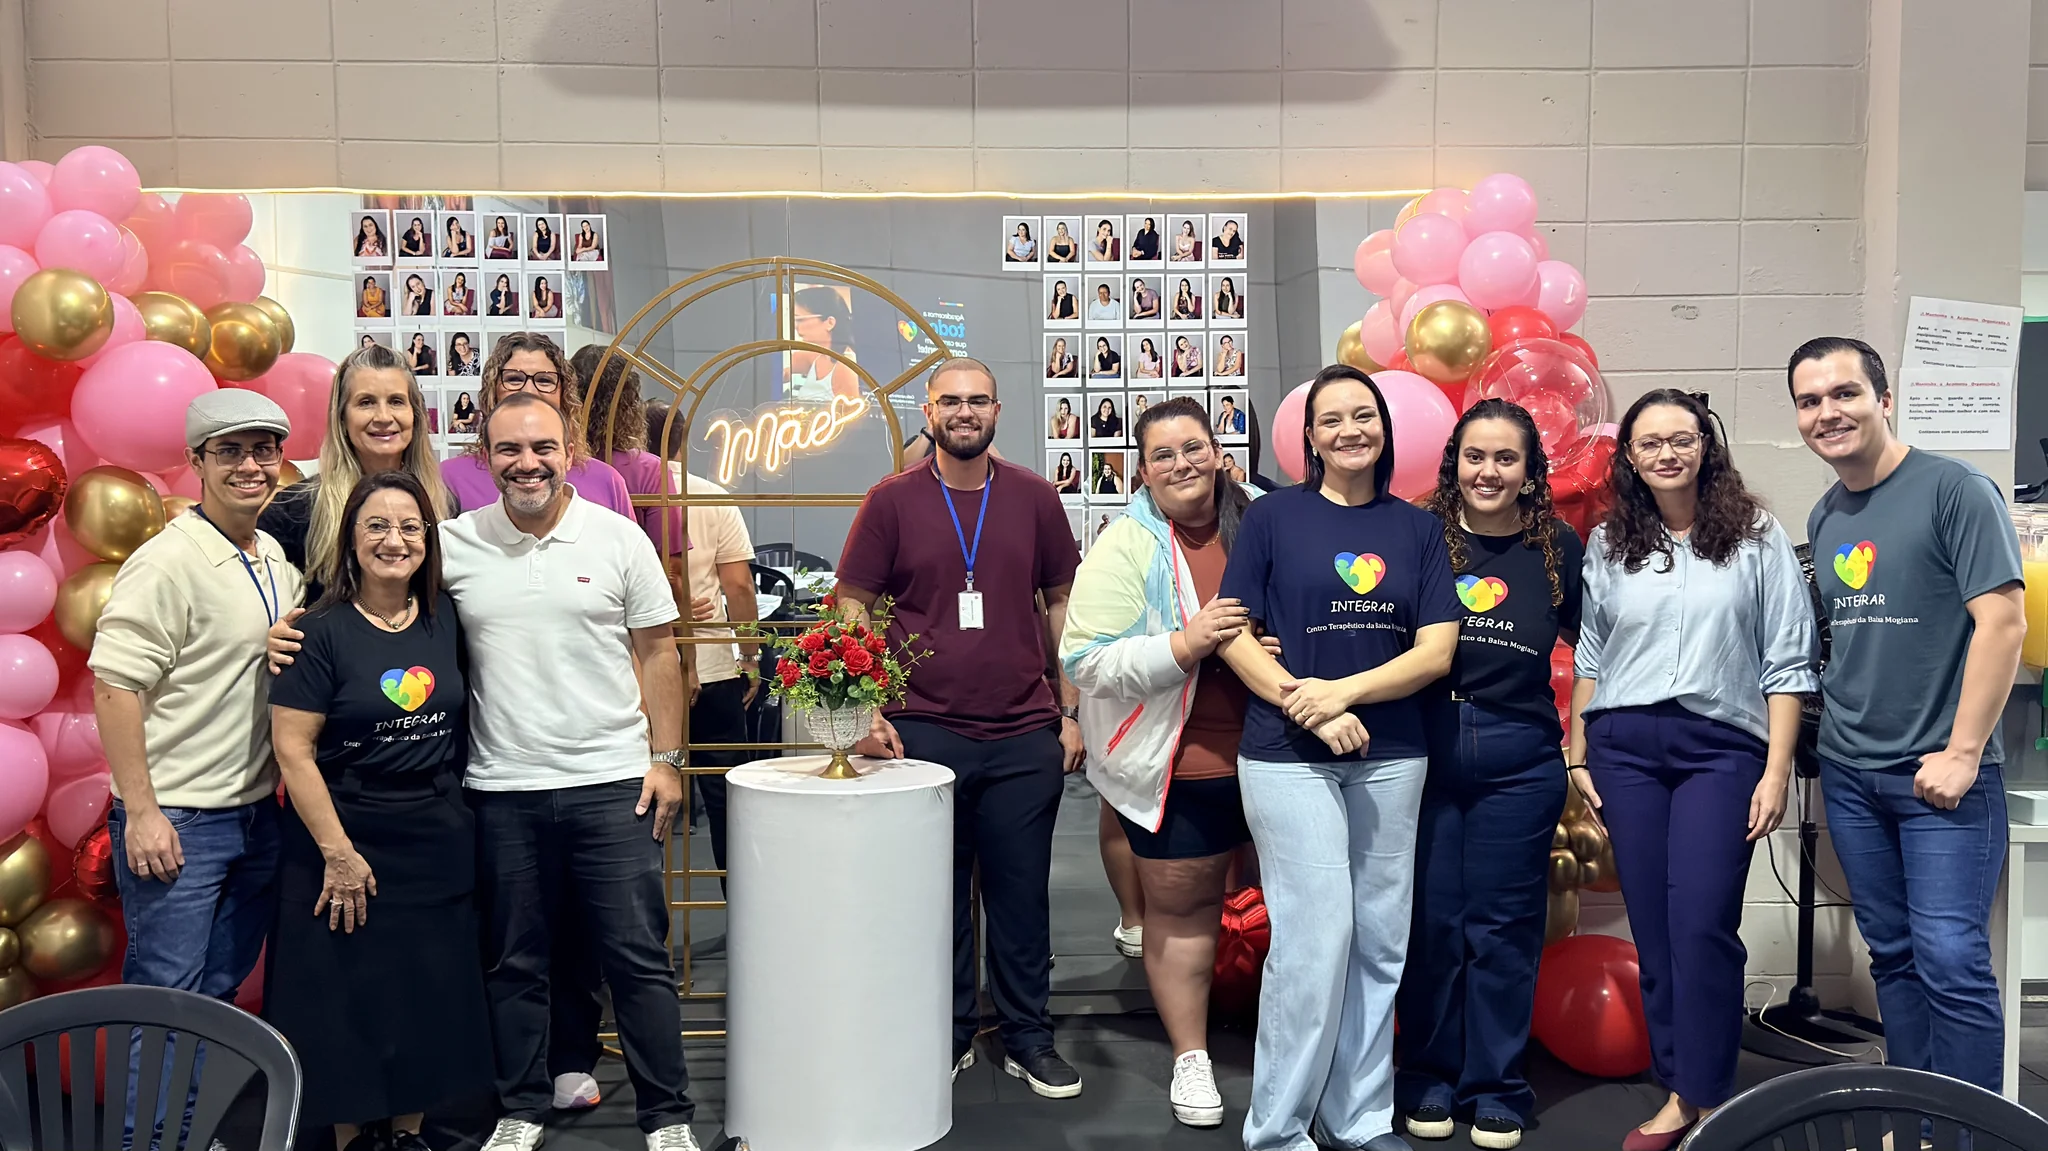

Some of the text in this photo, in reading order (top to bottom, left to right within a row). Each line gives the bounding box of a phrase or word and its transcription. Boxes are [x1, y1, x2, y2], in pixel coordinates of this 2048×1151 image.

[1331, 600, 1395, 613] INTEGRAR
[1885, 616, 1919, 625] Mogiana
[1306, 626, 1328, 634] Centro
[1328, 622, 1365, 630] Terapêutico
[1477, 635, 1486, 643] da
[1488, 637, 1508, 647] Baixa
[1510, 642, 1539, 656] Mogiana
[374, 712, 446, 732] INTEGRAR
